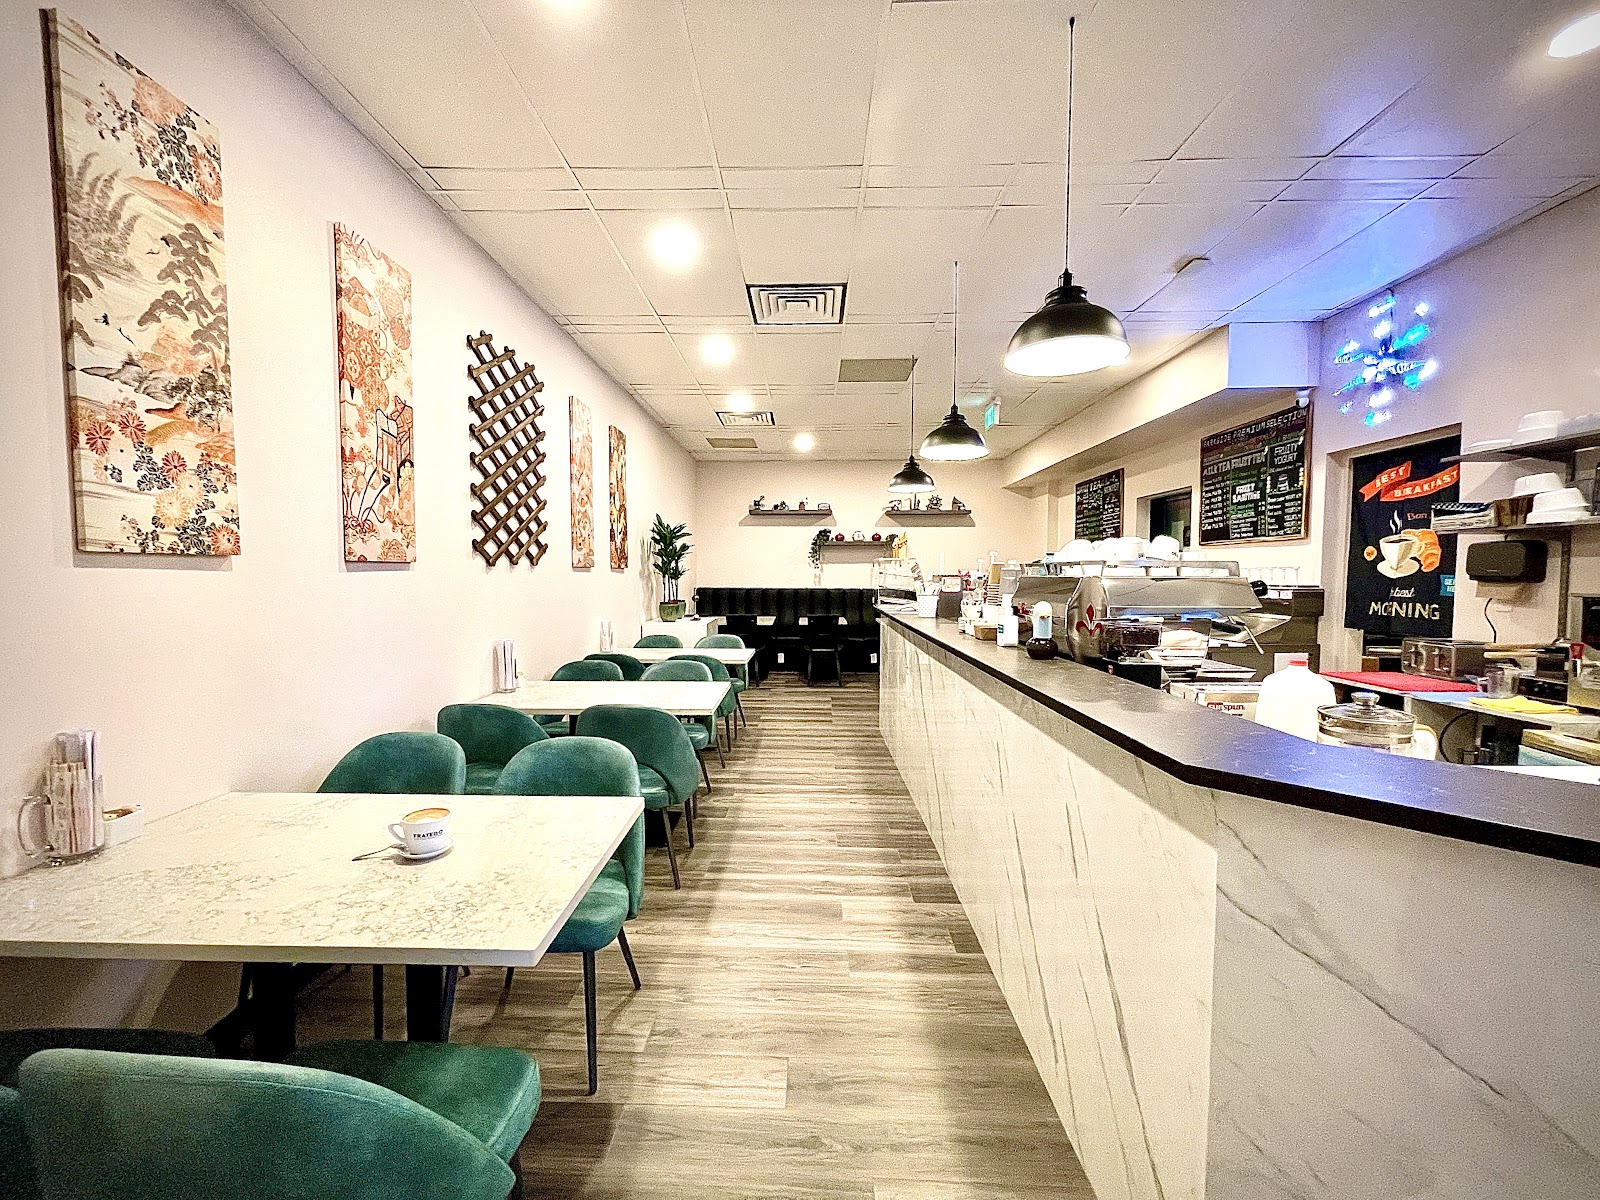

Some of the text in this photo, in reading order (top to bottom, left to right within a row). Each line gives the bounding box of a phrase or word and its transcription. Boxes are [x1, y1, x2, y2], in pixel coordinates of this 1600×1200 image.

[1232, 421, 1266, 439] PREMIUM
[1266, 409, 1307, 428] SELECTION
[1273, 443, 1299, 457] FRUITY
[1218, 457, 1231, 472] TEA
[1273, 452, 1298, 465] YOGURT
[1368, 601, 1440, 620] MONING
